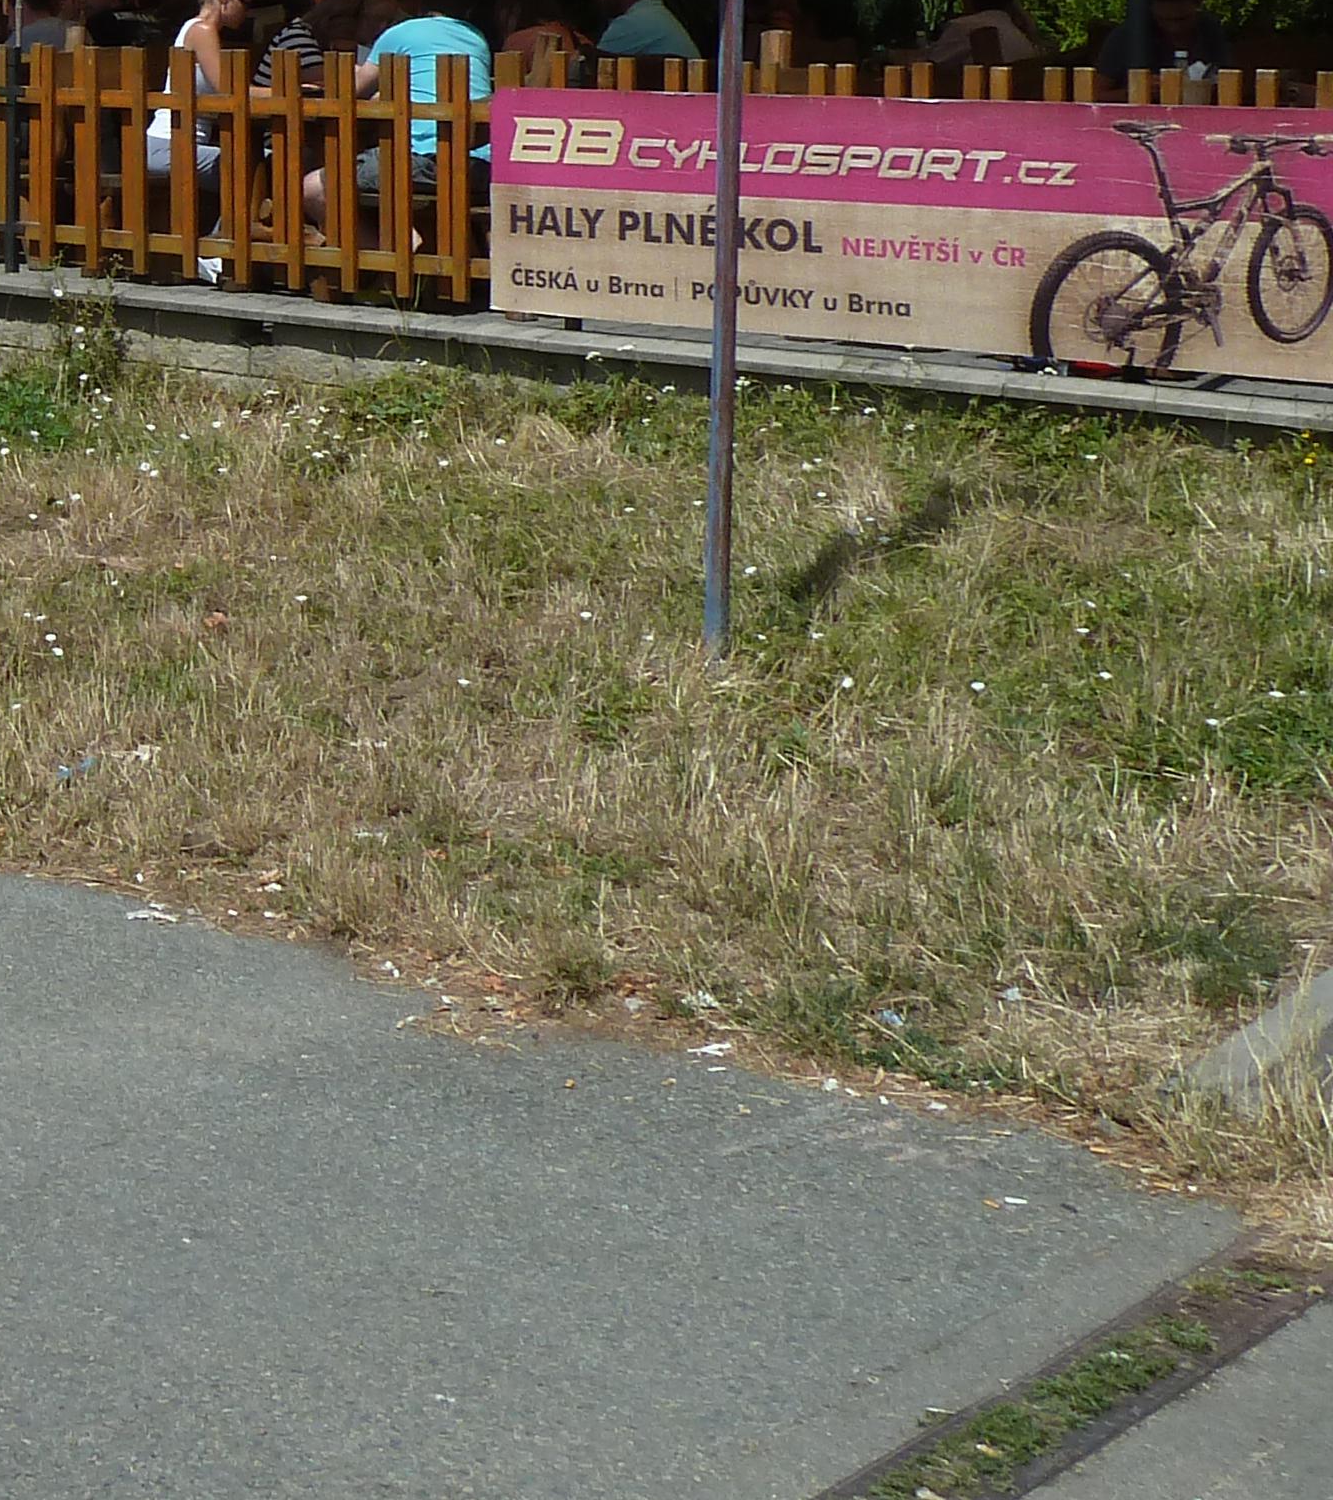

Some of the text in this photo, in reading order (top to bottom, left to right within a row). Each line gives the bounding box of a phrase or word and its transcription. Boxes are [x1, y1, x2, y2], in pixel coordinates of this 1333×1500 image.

[509, 203, 1026, 268] HALY PLNÉ KOL NEJVĚTŠÍ v ČR
[511, 262, 579, 291] ČESKÁ
[586, 279, 599, 293] u
[608, 275, 664, 298] Brna
[823, 296, 837, 311] u
[848, 292, 911, 317] Brna
